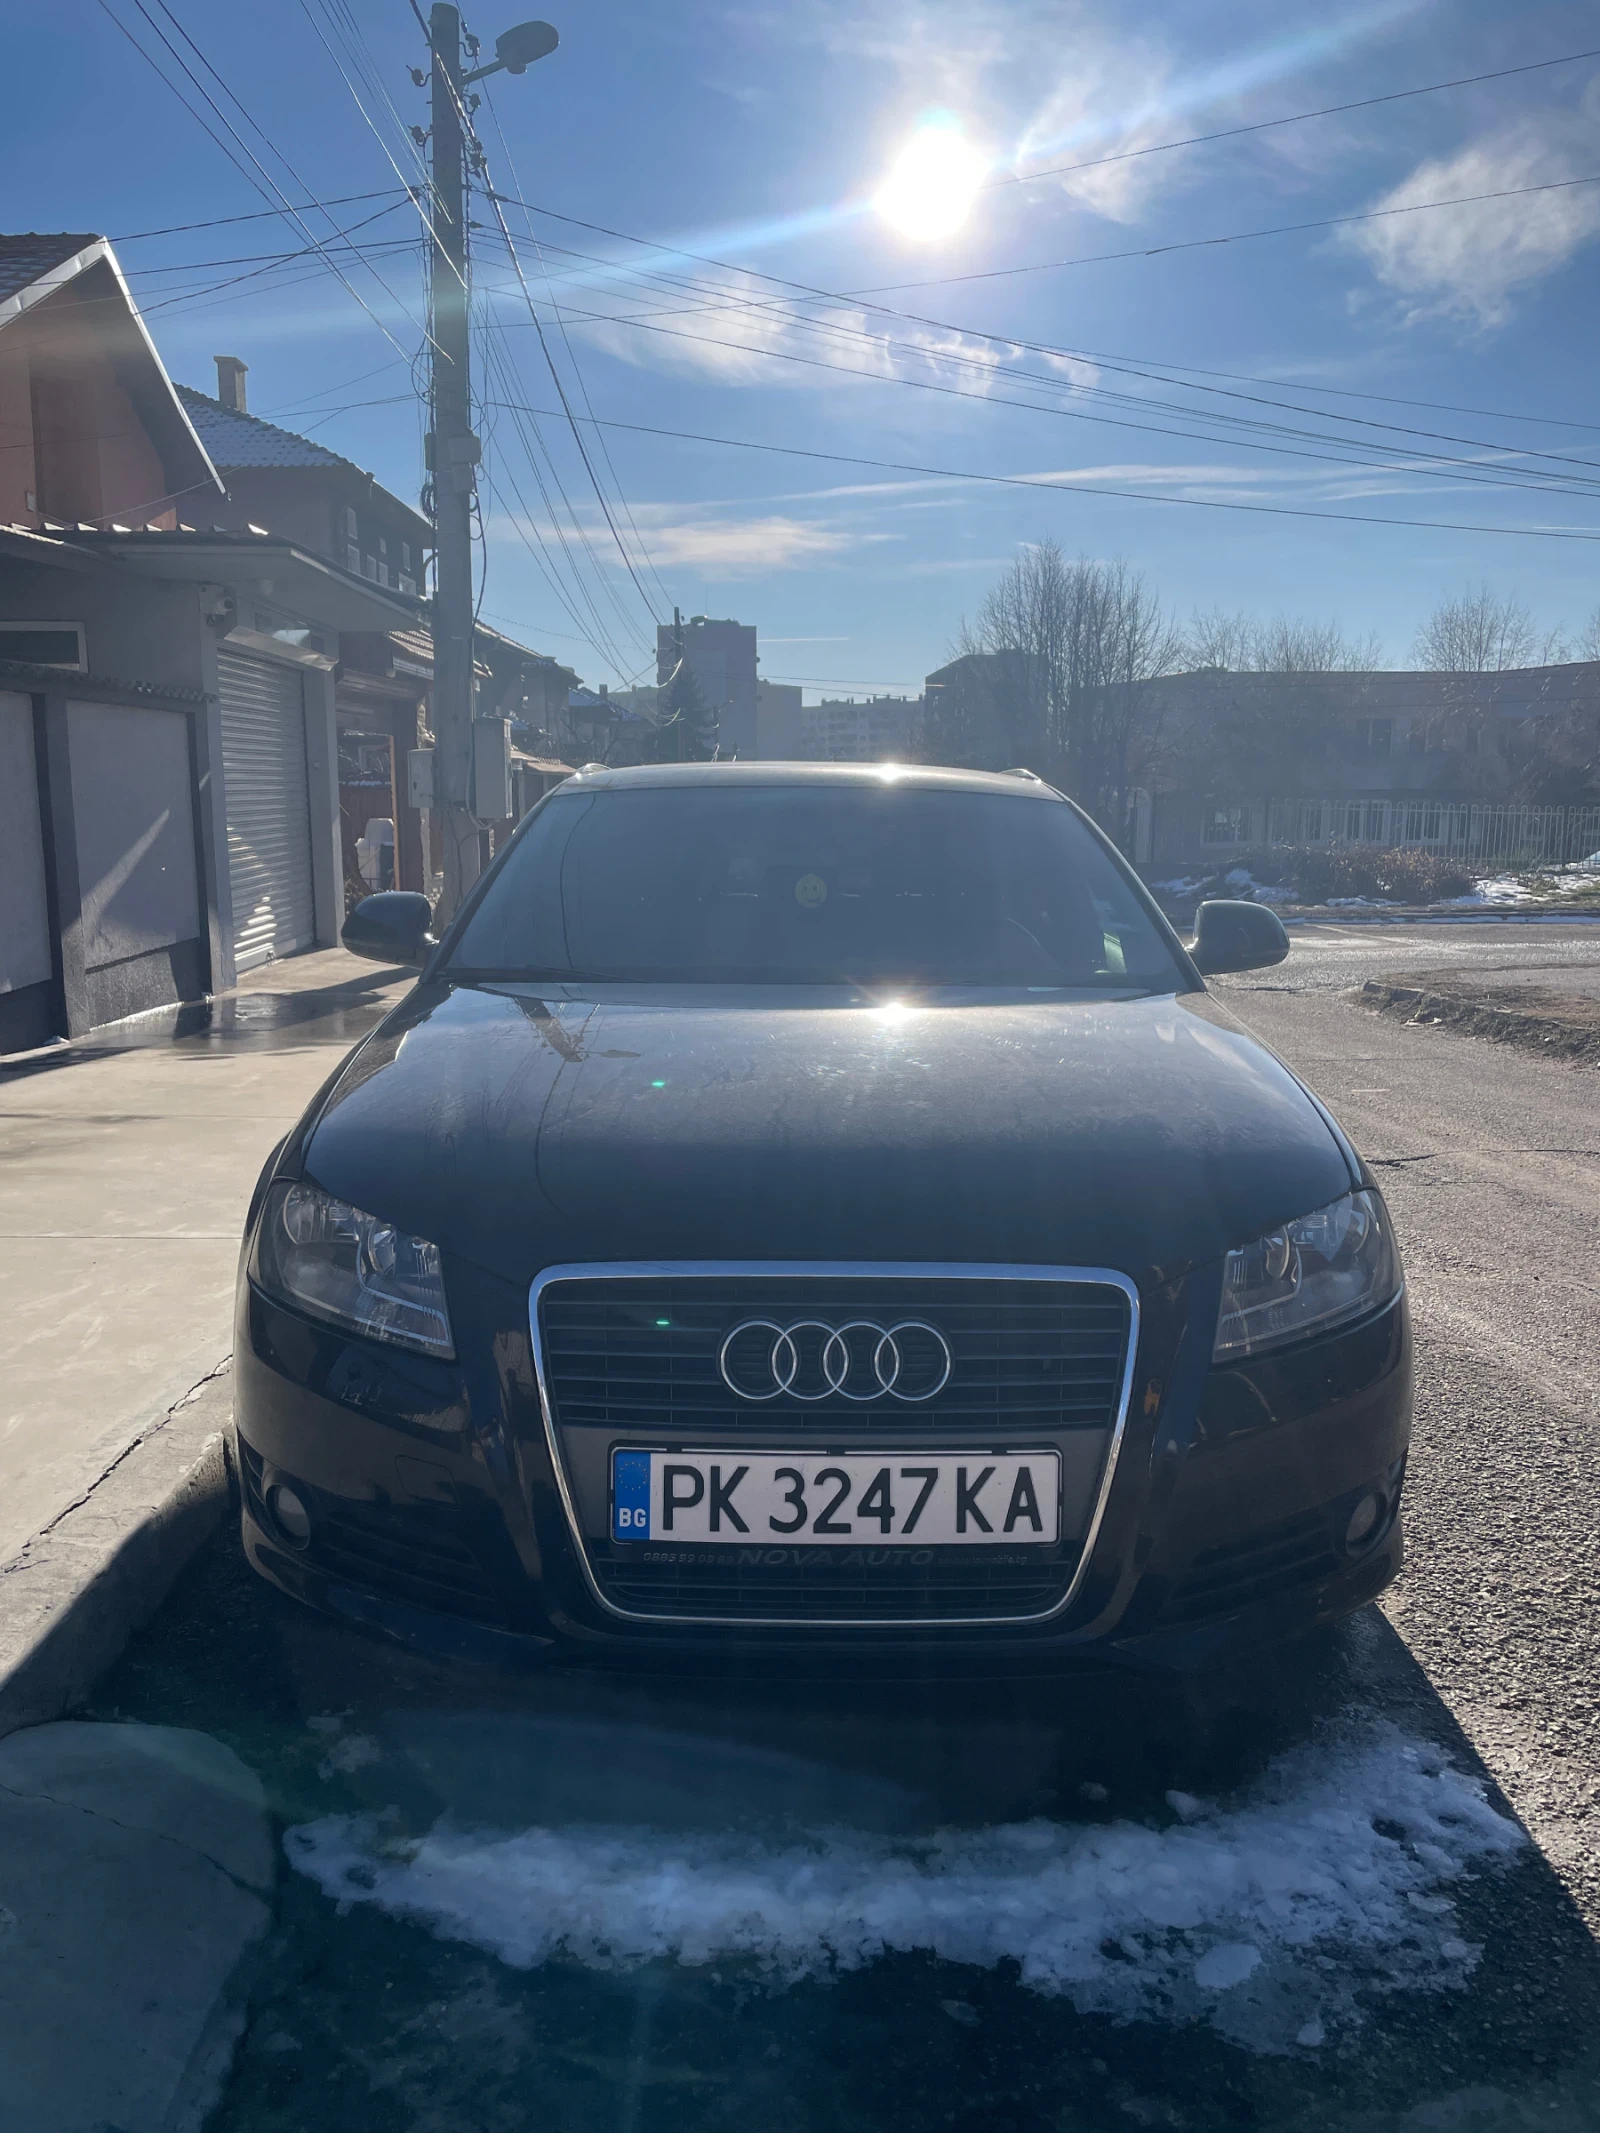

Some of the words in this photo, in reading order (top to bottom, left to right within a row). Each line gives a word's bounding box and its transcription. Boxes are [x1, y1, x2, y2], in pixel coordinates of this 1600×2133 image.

[663, 1465, 750, 1533] PK
[769, 1467, 938, 1534] 3247
[956, 1467, 1043, 1533] KA
[619, 1508, 646, 1527] BG
[643, 1552, 677, 1562] 0885
[738, 1549, 832, 1564] NOVA
[841, 1550, 934, 1565] AUTO
